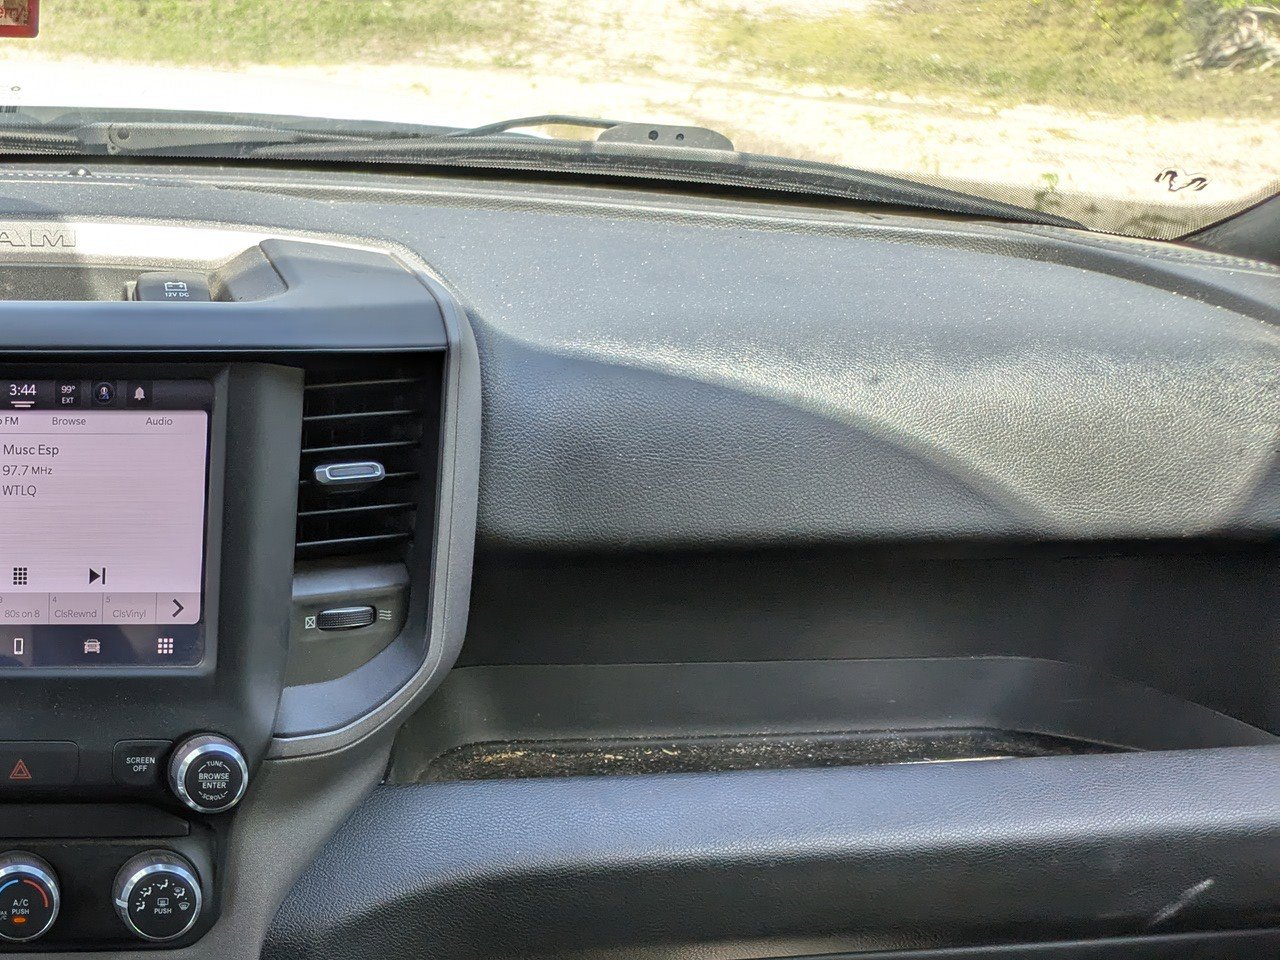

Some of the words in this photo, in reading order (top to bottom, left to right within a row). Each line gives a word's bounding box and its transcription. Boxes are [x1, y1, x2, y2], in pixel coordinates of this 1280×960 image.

[9, 384, 36, 396] 3:44
[61, 385, 76, 394] 99°
[4, 417, 19, 426] FM
[52, 417, 86, 426] Browse
[145, 417, 173, 426] Audio
[3, 444, 36, 456] Musc
[38, 444, 60, 457] Esp
[2, 464, 29, 476] 97.7
[31, 466, 53, 476] MHz
[2, 485, 37, 496] WTLQ
[4, 610, 20, 618] 80s
[34, 610, 40, 618] 8
[54, 609, 97, 618] ClsRewnd
[112, 609, 146, 620] ClsVinyl
[202, 793, 226, 801] SCROLL
[12, 898, 29, 907] A/C
